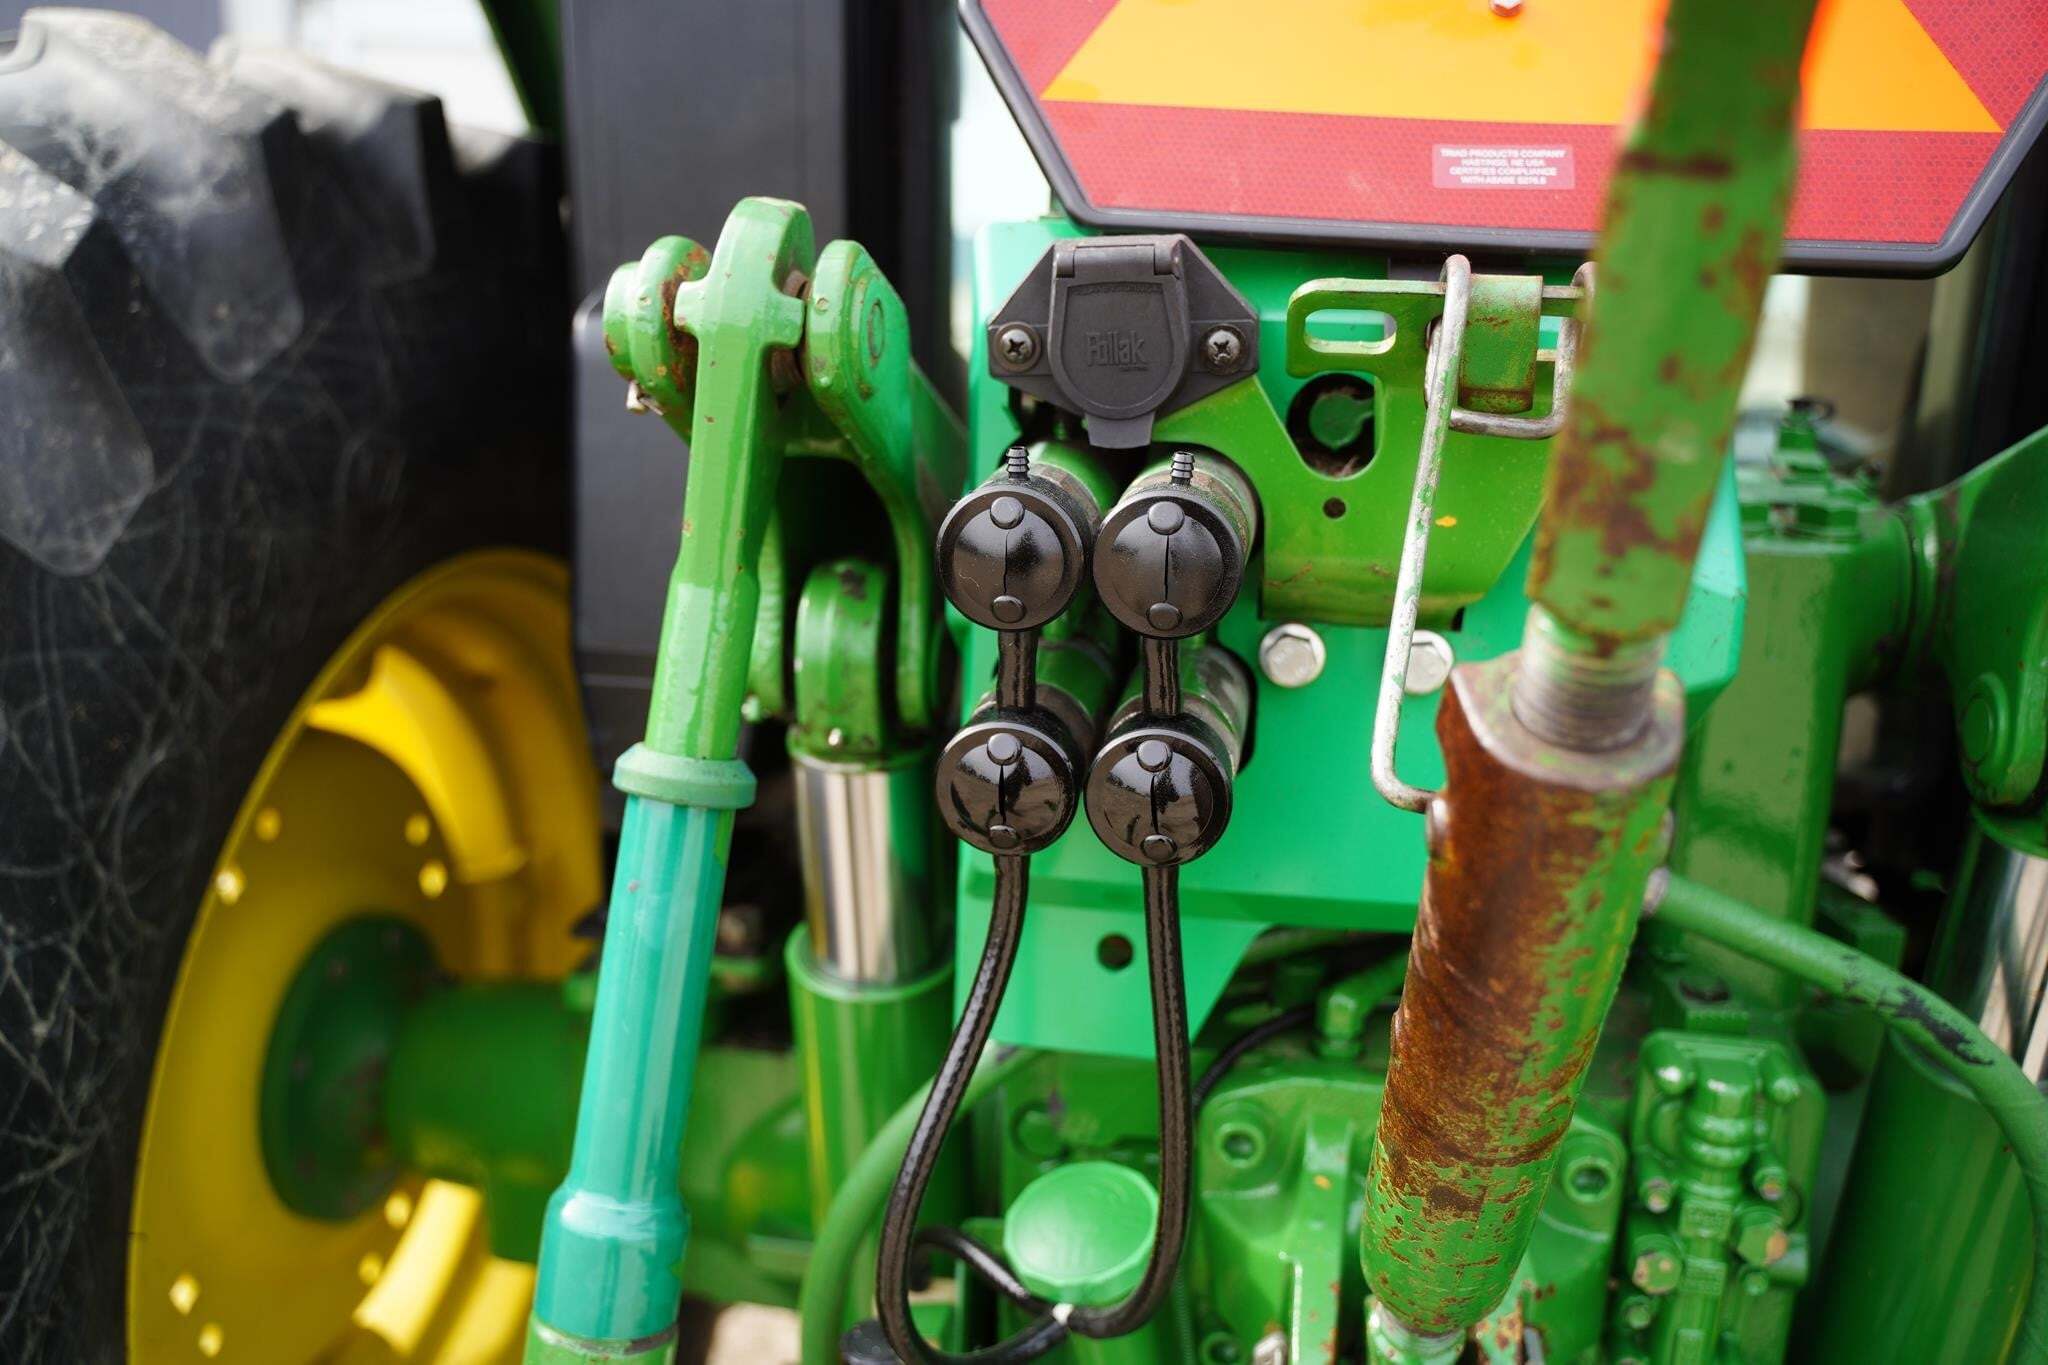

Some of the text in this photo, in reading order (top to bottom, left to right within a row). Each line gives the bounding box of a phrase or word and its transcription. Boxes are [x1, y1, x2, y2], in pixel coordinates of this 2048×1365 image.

[1469, 148, 1518, 158] PRODUCTS
[1519, 149, 1565, 158] COMPANY
[1497, 167, 1557, 176] COMPLIANCE
